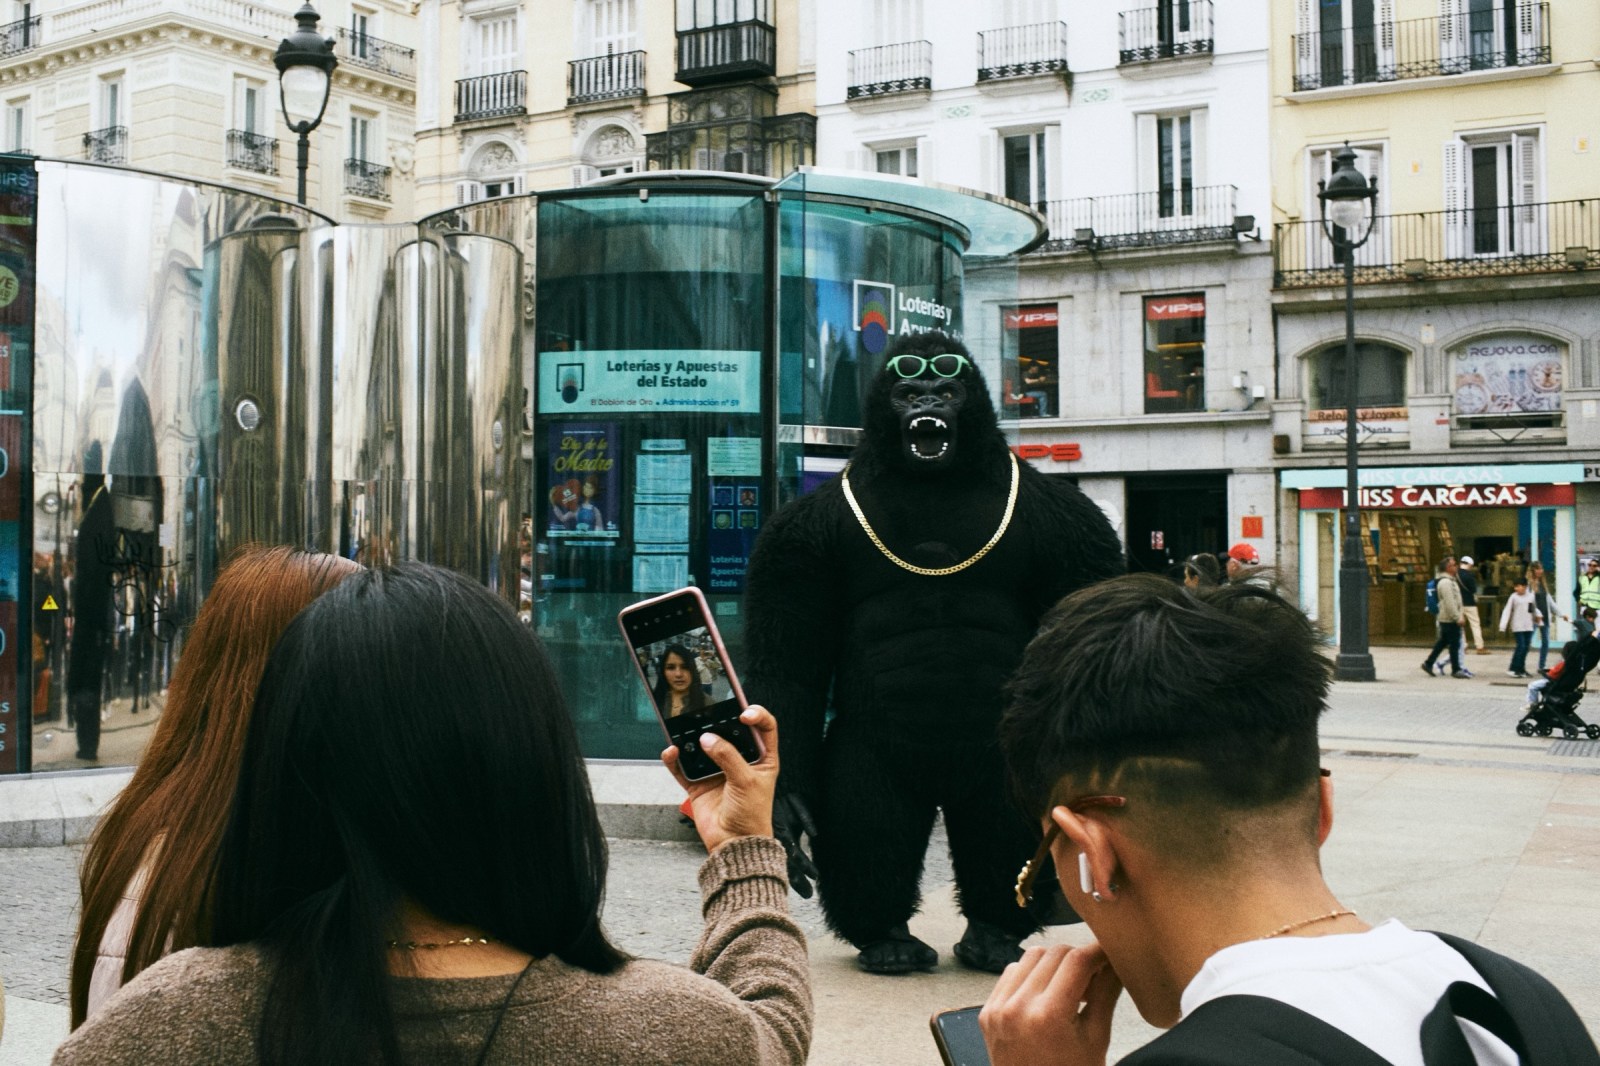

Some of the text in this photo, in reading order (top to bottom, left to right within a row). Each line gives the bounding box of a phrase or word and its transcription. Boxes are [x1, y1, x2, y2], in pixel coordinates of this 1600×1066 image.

[899, 292, 953, 326] Loterías y
[1151, 303, 1204, 314] VIPS
[1009, 312, 1058, 322] VIPS
[607, 359, 738, 375] Loterías y Apuestas
[636, 375, 707, 388] del Estado
[639, 398, 653, 406] Oro
[554, 449, 614, 472] Madre
[1401, 468, 1504, 483] CARCASAS
[1401, 486, 1528, 507] CARCASAS
